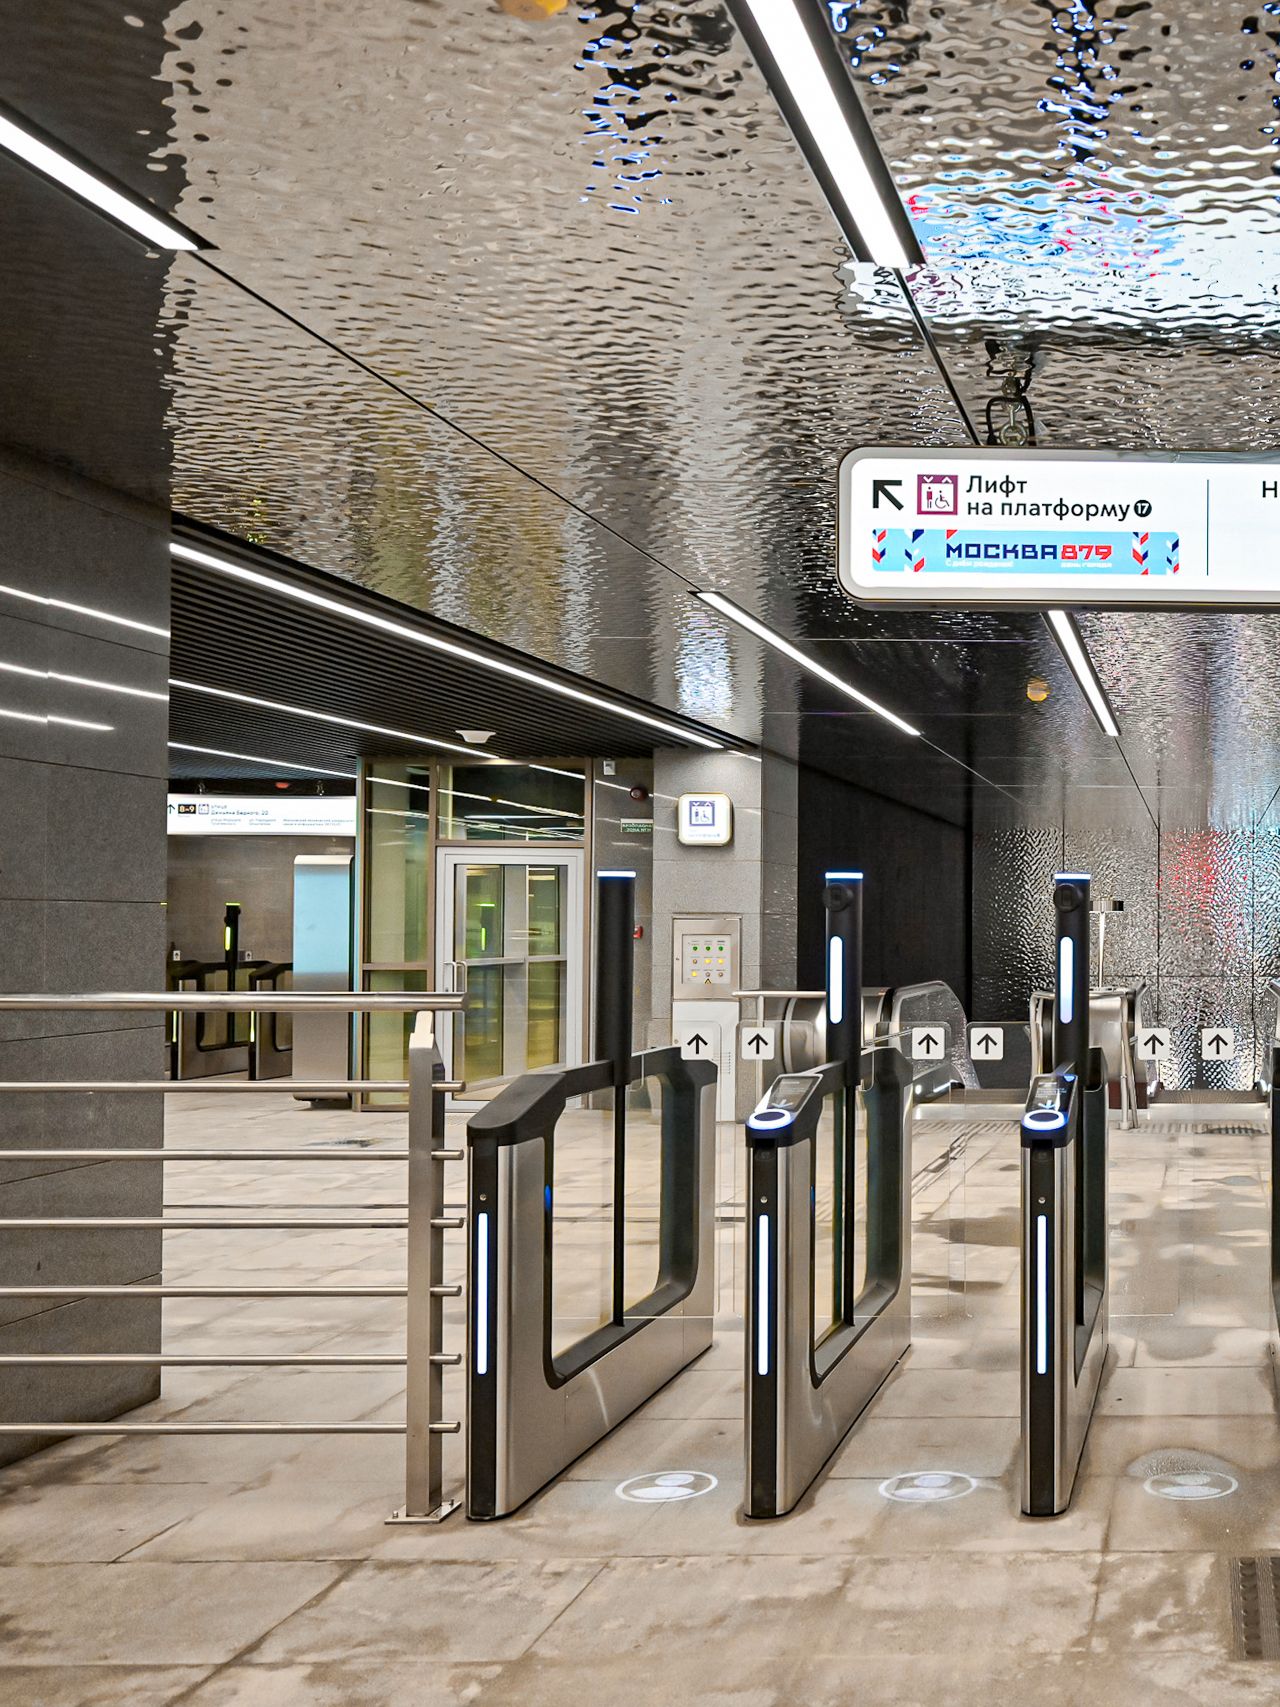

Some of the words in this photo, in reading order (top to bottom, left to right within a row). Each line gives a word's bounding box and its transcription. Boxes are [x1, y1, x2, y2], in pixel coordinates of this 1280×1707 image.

[966, 475, 1027, 497] Лифт
[967, 501, 993, 516] на
[1001, 498, 1131, 521] платформу
[946, 543, 1057, 560] МОСКВА
[1061, 545, 1112, 560] 879
